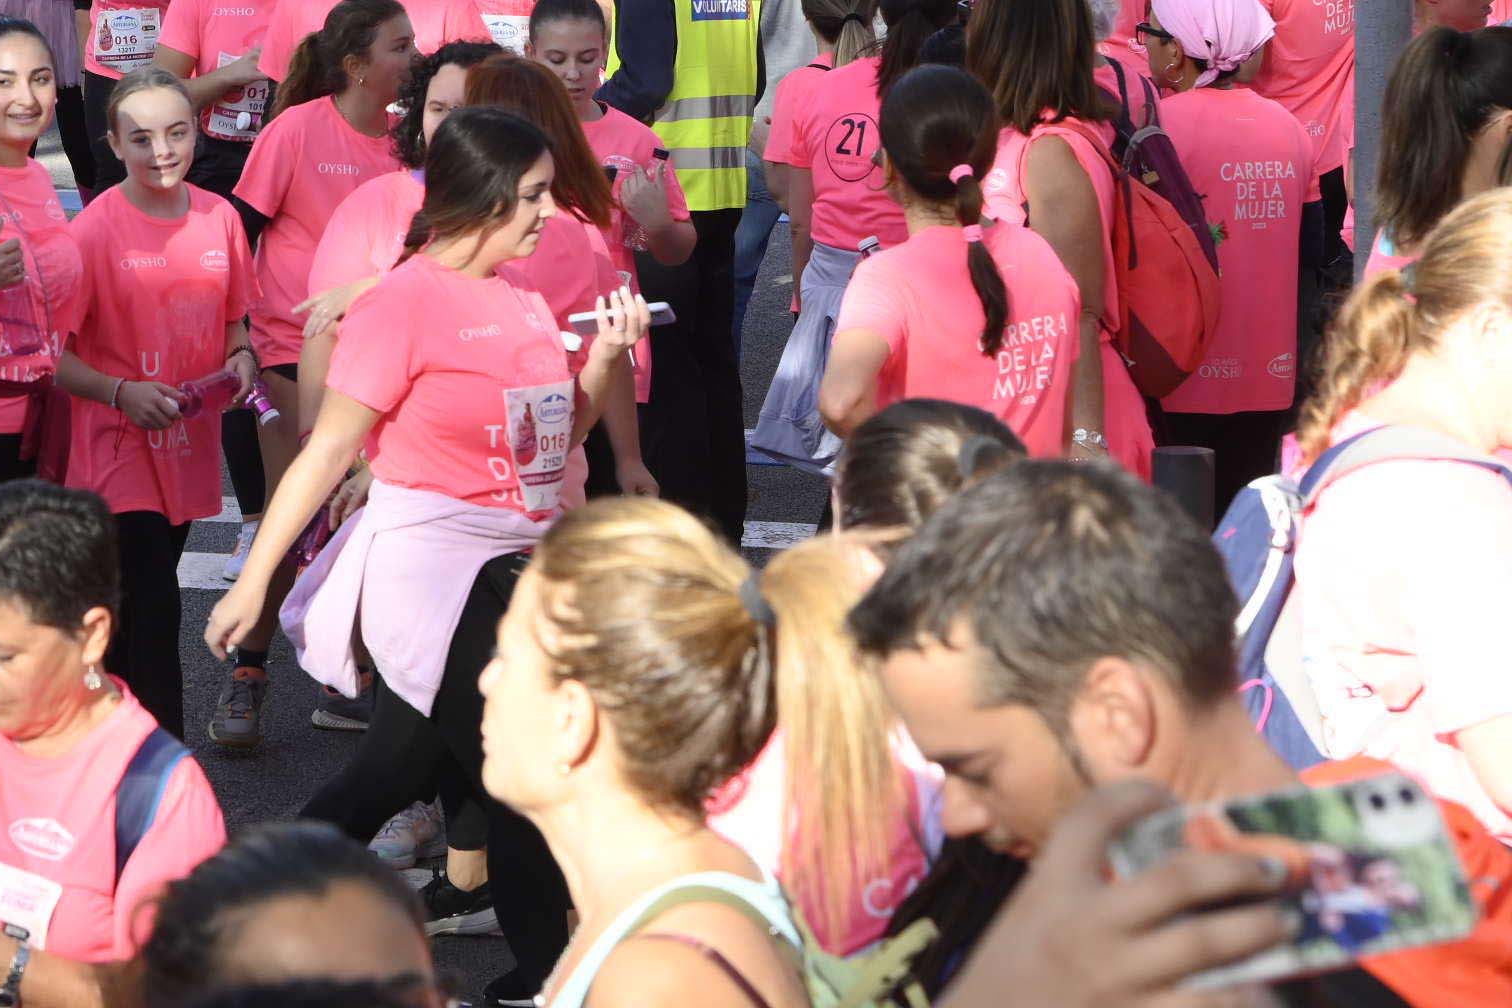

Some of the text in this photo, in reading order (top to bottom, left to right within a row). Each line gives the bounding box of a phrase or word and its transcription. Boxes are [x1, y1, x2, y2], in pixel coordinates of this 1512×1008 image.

[1326, 0, 1344, 19] DE
[114, 35, 138, 46] 016
[117, 46, 136, 54] 13217
[835, 118, 867, 157] 21
[317, 162, 360, 176] OYSHO
[1220, 160, 1296, 181] CARRERA
[1236, 180, 1283, 200] DE LA
[1234, 201, 1287, 220] MUJER
[120, 256, 167, 271] OYSHO
[997, 341, 1055, 375] DE LA
[540, 432, 566, 452] 016
